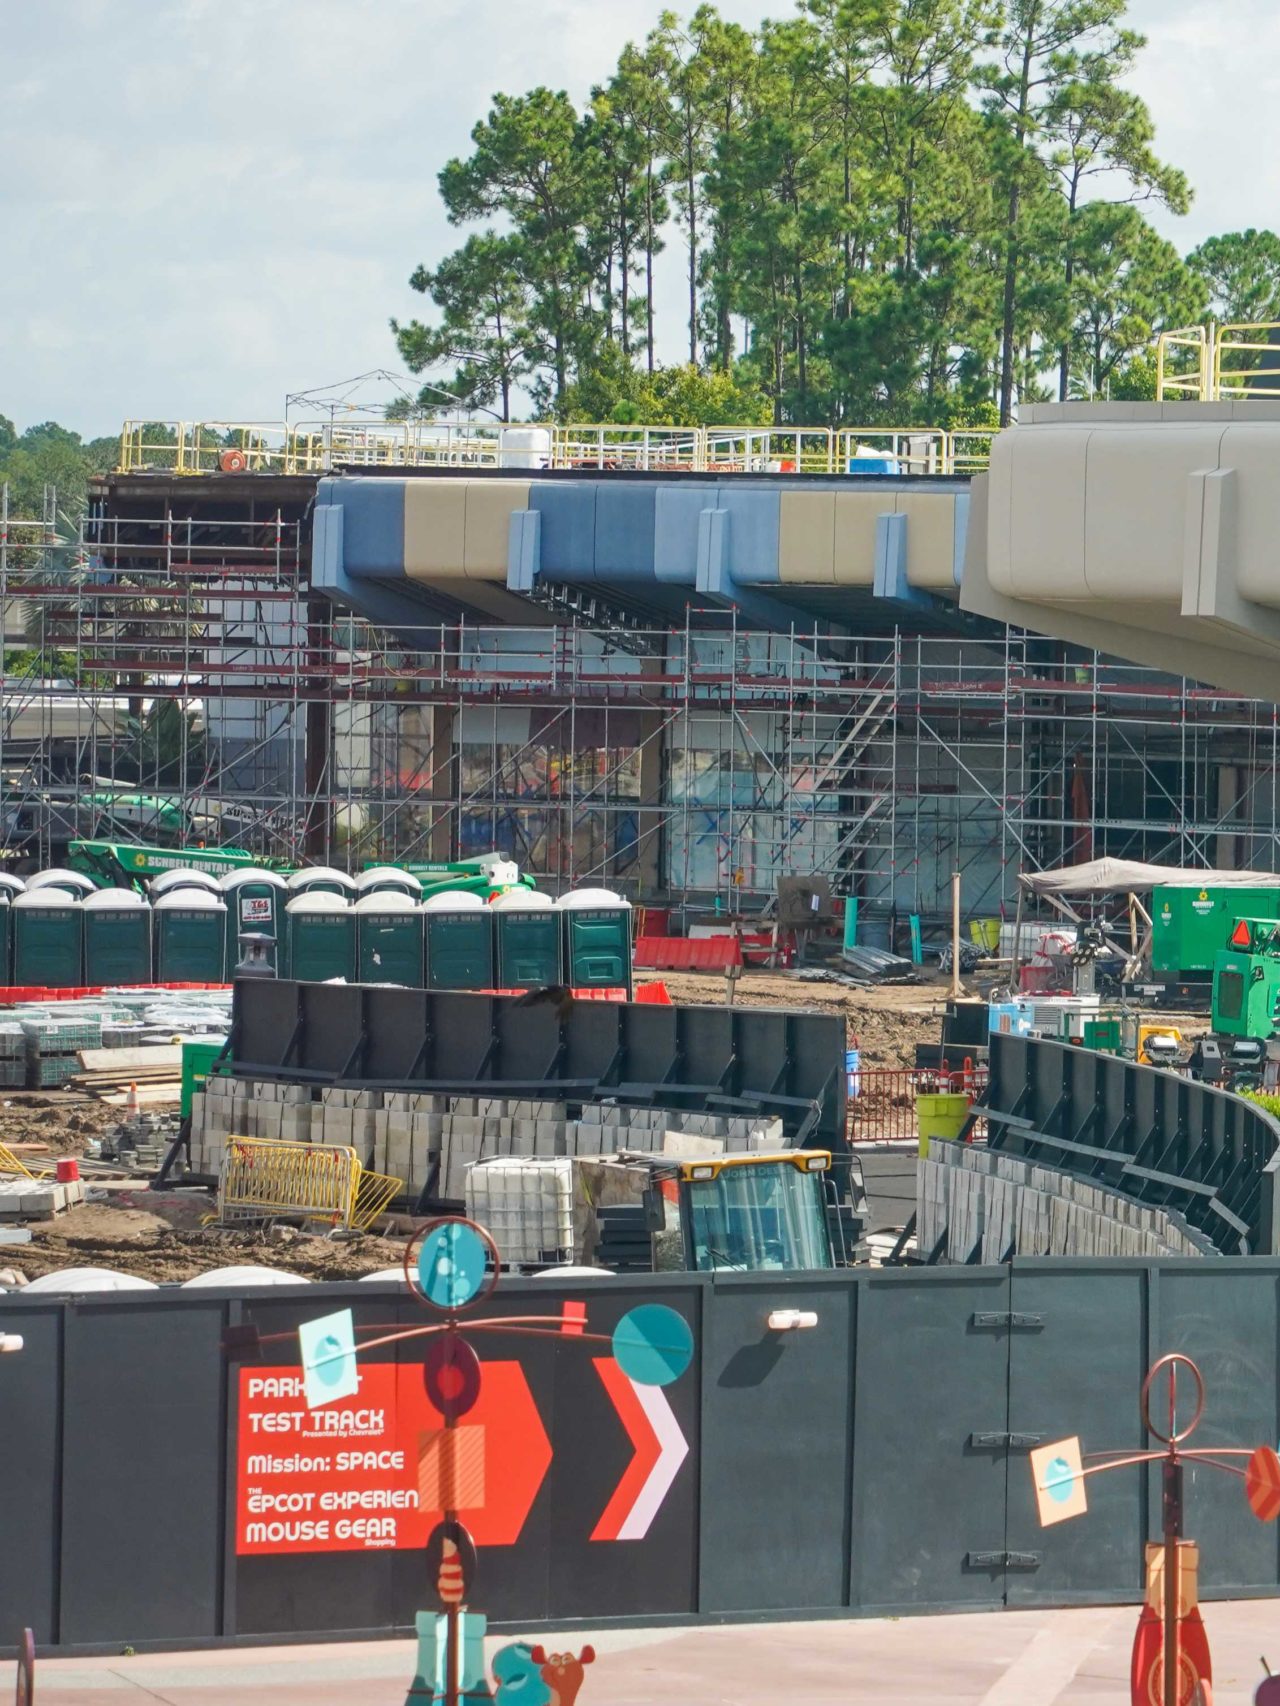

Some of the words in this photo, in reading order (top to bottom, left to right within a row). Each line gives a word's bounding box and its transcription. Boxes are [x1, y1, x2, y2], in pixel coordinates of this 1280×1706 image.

[147, 856, 190, 869] SUNBELT
[192, 859, 235, 873] RENTALS
[724, 1167, 755, 1178] JOHN
[248, 1411, 305, 1433] TEST
[310, 1409, 385, 1431] TRACK
[302, 1430, 337, 1438] Presented
[338, 1429, 348, 1438] by
[247, 1453, 331, 1474] Mission:
[336, 1451, 404, 1471] SPACE
[247, 1493, 316, 1513] EPCOT
[319, 1490, 419, 1511] EXPERIEN
[246, 1520, 329, 1543] MOUSE
[334, 1517, 396, 1539] GEAR
[364, 1539, 396, 1547] Shopping
